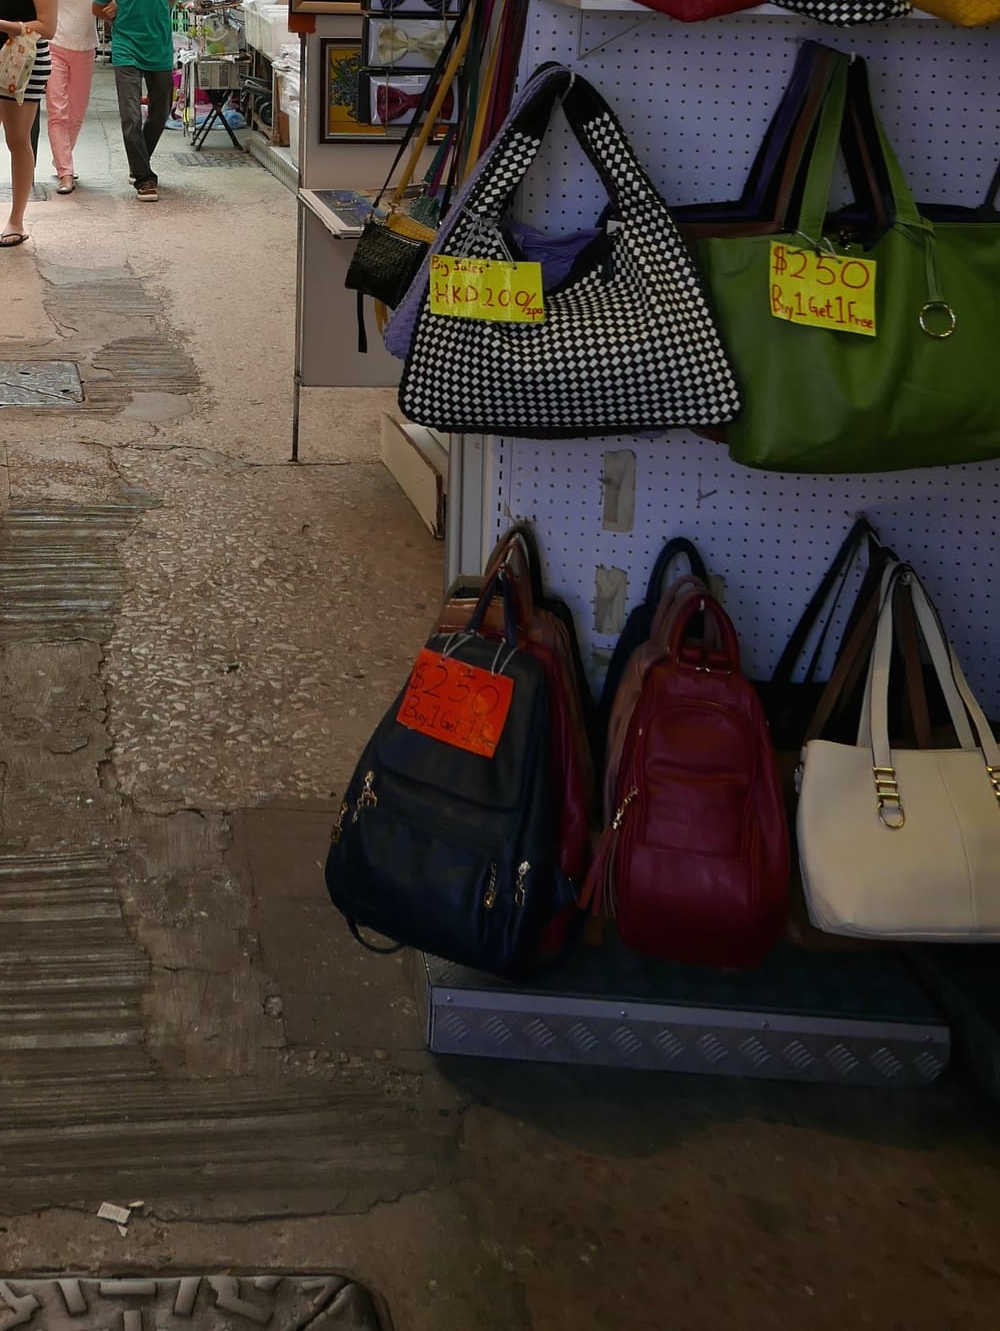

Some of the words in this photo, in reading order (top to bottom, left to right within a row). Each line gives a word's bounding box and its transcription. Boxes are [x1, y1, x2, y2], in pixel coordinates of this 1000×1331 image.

[431, 255, 450, 277] Big
[773, 245, 870, 290] $250
[771, 283, 794, 321] Buy
[794, 291, 807, 316] 1
[808, 296, 834, 320] Get
[835, 295, 847, 324] 1
[847, 300, 874, 329] Free
[411, 662, 500, 716] $250
[402, 694, 427, 725] Buy
[440, 710, 464, 734] Get
